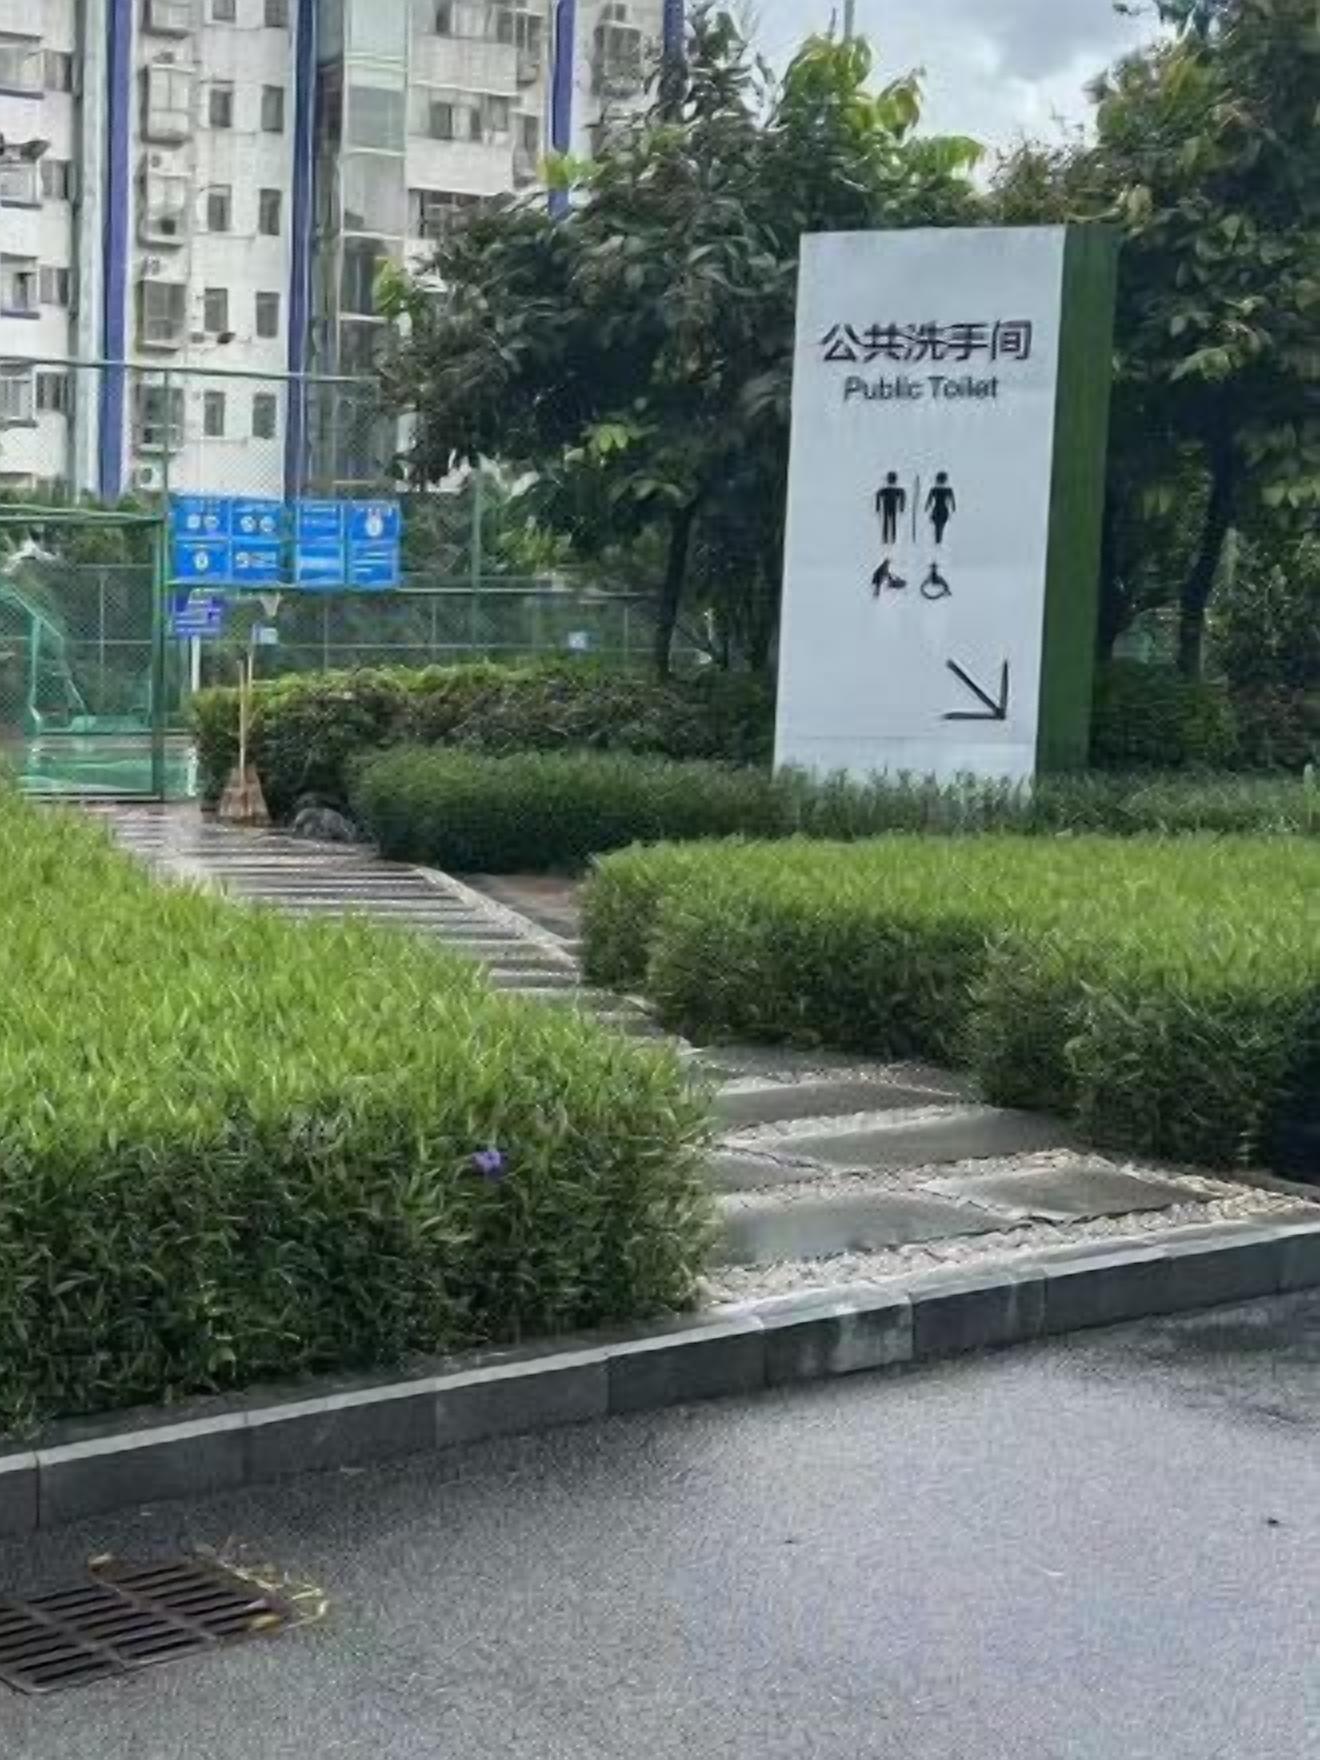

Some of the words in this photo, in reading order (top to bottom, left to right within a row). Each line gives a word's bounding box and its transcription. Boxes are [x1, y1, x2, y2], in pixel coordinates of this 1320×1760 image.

[821, 320, 1032, 362] 公共洗手间
[844, 376, 923, 400] Public
[928, 376, 998, 399] Toilet
